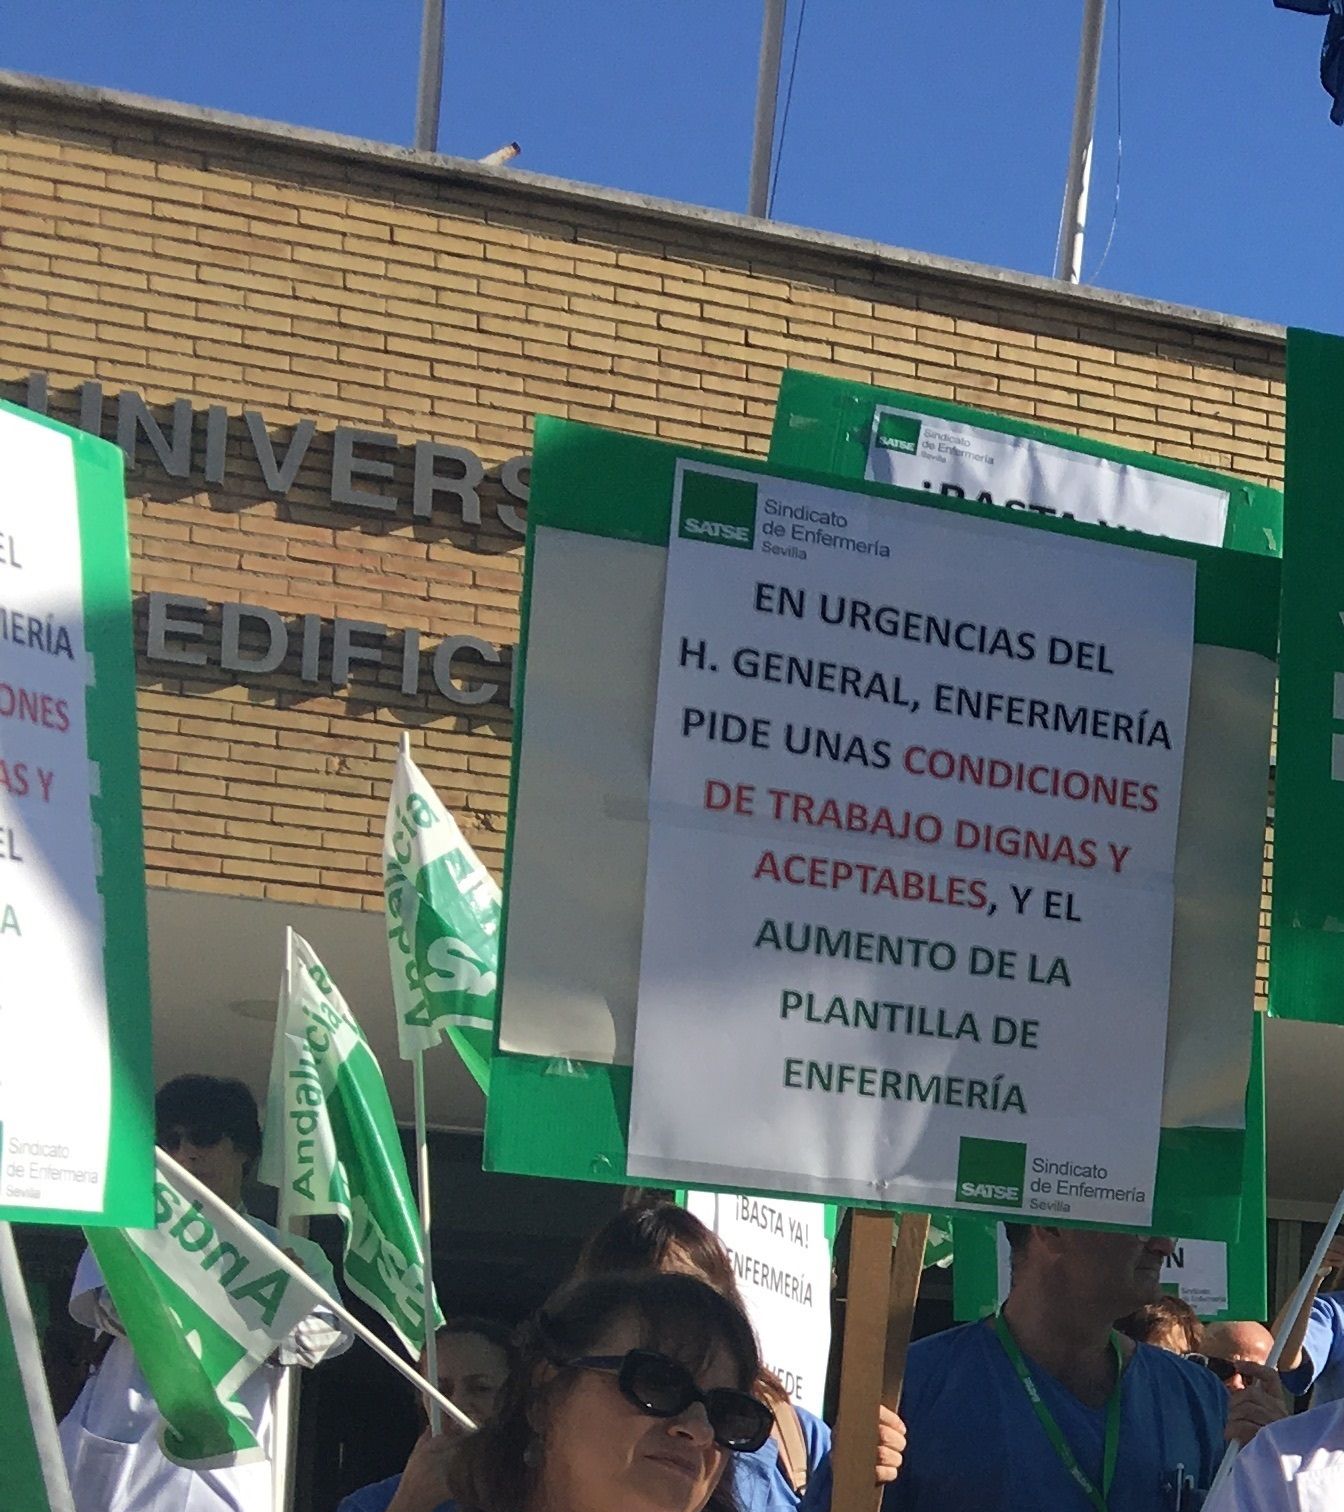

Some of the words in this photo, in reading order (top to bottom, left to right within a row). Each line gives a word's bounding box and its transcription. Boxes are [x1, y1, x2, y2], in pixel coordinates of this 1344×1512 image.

[923, 428, 971, 447] Sindicato
[684, 517, 750, 542] SATSE
[764, 499, 848, 528] Sindicato
[761, 541, 807, 560] Sevilla
[762, 520, 786, 537] de
[791, 525, 891, 558] Enfermería
[754, 581, 805, 620] EN
[820, 592, 1036, 661] URGENCIAS
[1048, 637, 1114, 674] DEL
[146, 592, 520, 709] EDIFIC
[679, 637, 717, 673] H.
[733, 647, 920, 714] GENERAL,
[934, 684, 1172, 750] ENFERMERÍA
[681, 708, 771, 750] PIDE
[784, 724, 891, 770] UNAS
[903, 744, 1159, 813] CONDICIONES
[37, 768, 54, 802] Y
[705, 779, 753, 816] DE
[769, 789, 943, 845] TRABAJO
[955, 819, 1096, 869] DIGNAS
[1109, 844, 1131, 873] Y
[754, 850, 998, 916] ACEPTABLES,
[1011, 884, 1032, 914] Y
[1044, 890, 1081, 923] EL
[754, 919, 956, 972] AUMENTO
[969, 945, 1016, 980] DE
[1029, 954, 1072, 988] LA
[779, 989, 980, 1043] PLANTILLA
[992, 1017, 1039, 1049] DE
[783, 1056, 1028, 1114] ENFERMERÍA
[8, 1137, 70, 1158] Sindicato
[1032, 1157, 1108, 1179] Sindicato
[961, 1182, 1019, 1201] SATSE
[1029, 1199, 1071, 1213] Sevilla
[1030, 1178, 1052, 1193] de
[1057, 1181, 1146, 1203] Enfermería
[736, 1195, 784, 1238] ¡BASTA
[789, 1217, 809, 1248] YA!
